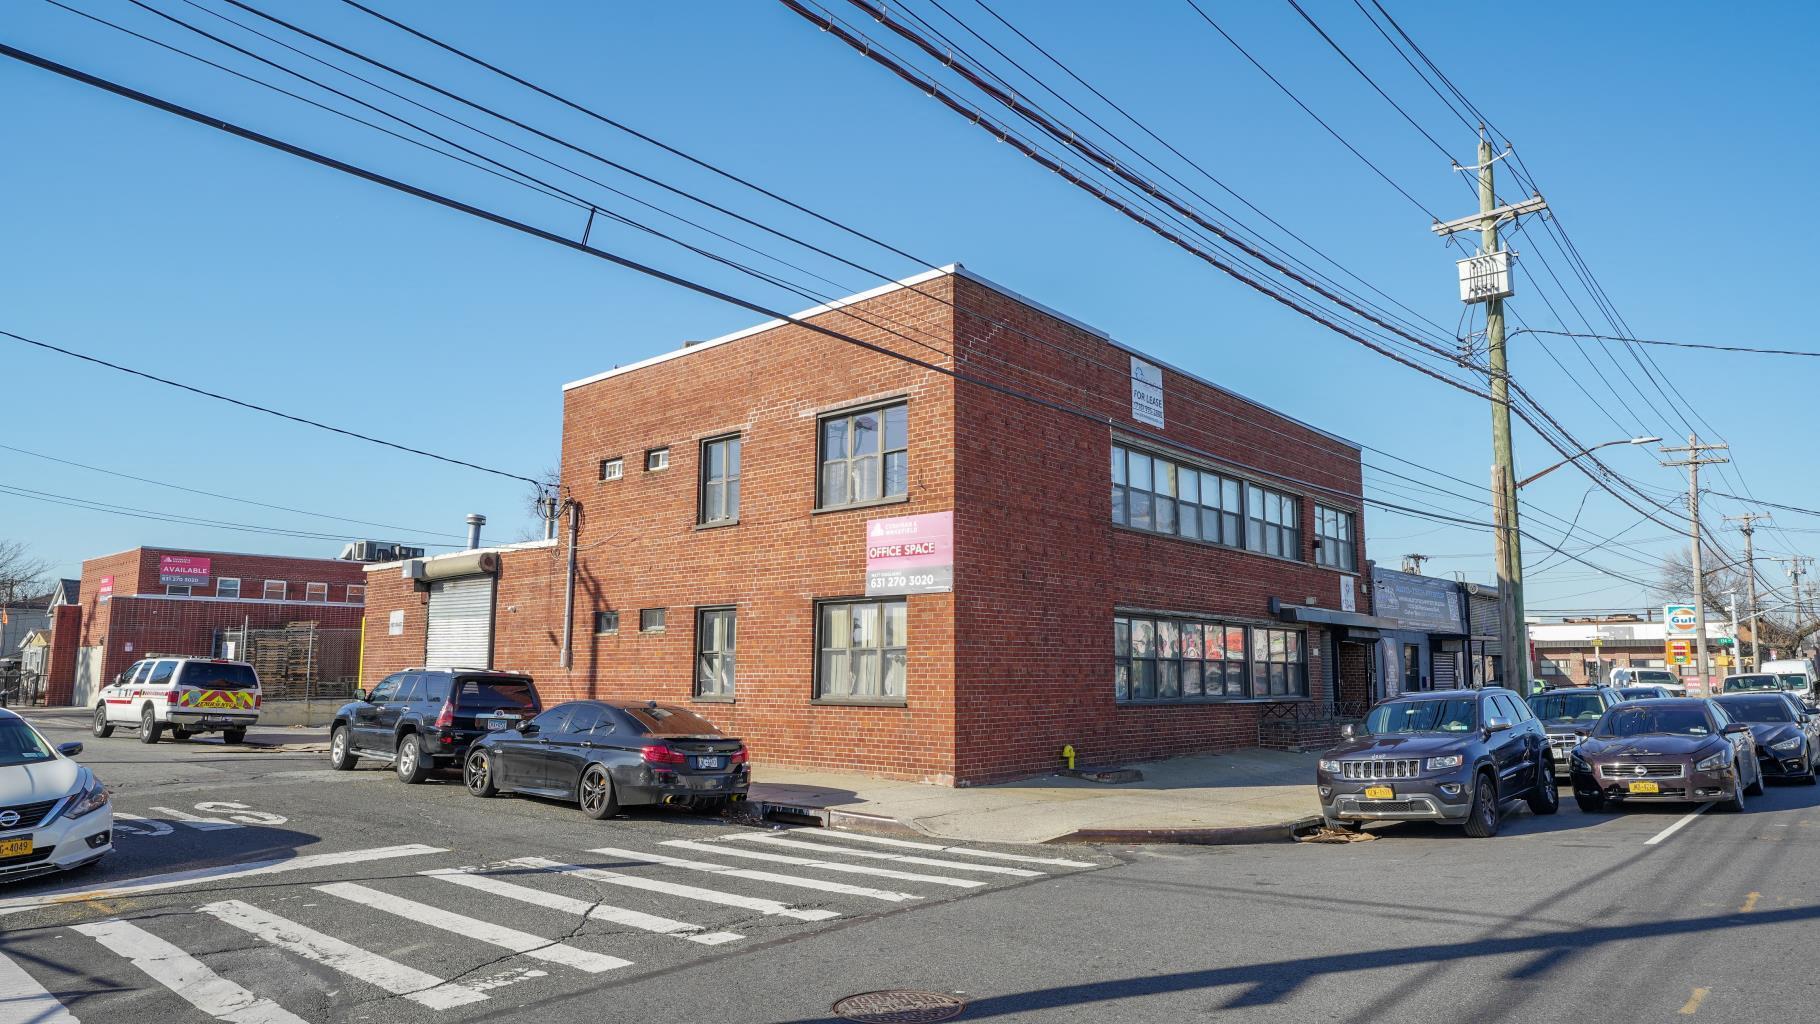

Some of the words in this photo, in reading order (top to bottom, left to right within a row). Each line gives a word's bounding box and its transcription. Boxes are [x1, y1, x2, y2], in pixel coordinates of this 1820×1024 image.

[1134, 389, 1145, 401] FOR
[1147, 394, 1162, 409] LEASE
[869, 545, 902, 558] OFFICE
[904, 542, 935, 556] SPACE
[163, 566, 208, 574] AVAILABLE
[870, 577, 886, 589] 631
[888, 576, 906, 587] 270
[909, 574, 934, 586] 3020
